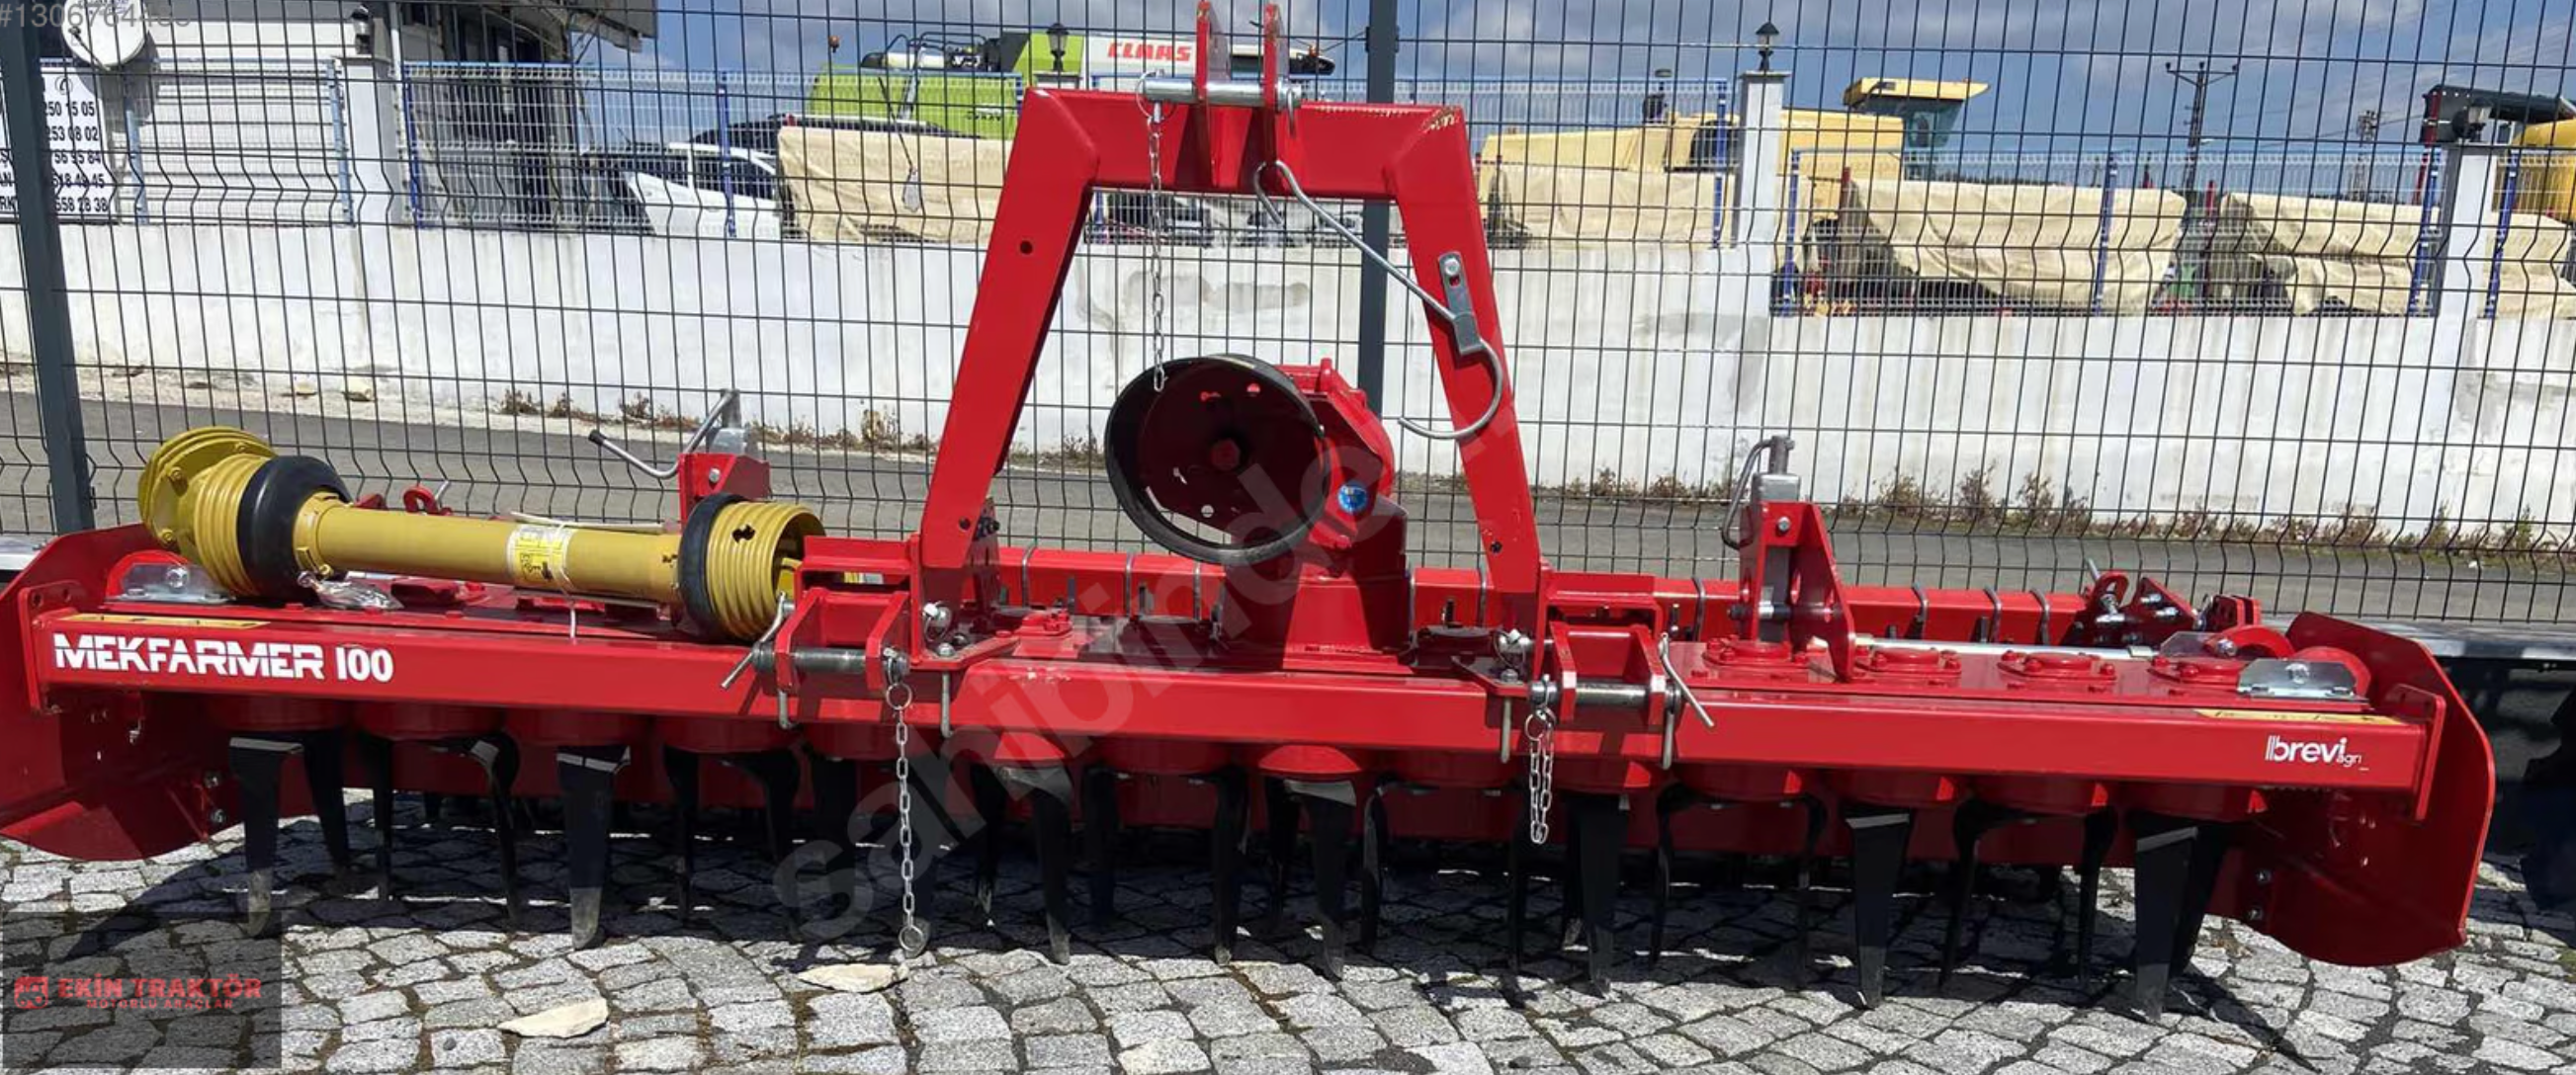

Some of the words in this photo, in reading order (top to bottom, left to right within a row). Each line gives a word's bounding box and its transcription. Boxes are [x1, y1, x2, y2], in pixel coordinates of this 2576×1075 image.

[1108, 42, 1191, 61] CLAAS
[81, 101, 95, 117] 05
[84, 125, 99, 141] 02
[94, 197, 109, 212] 38
[53, 633, 325, 680] MEKFARMER
[336, 645, 394, 683] 100
